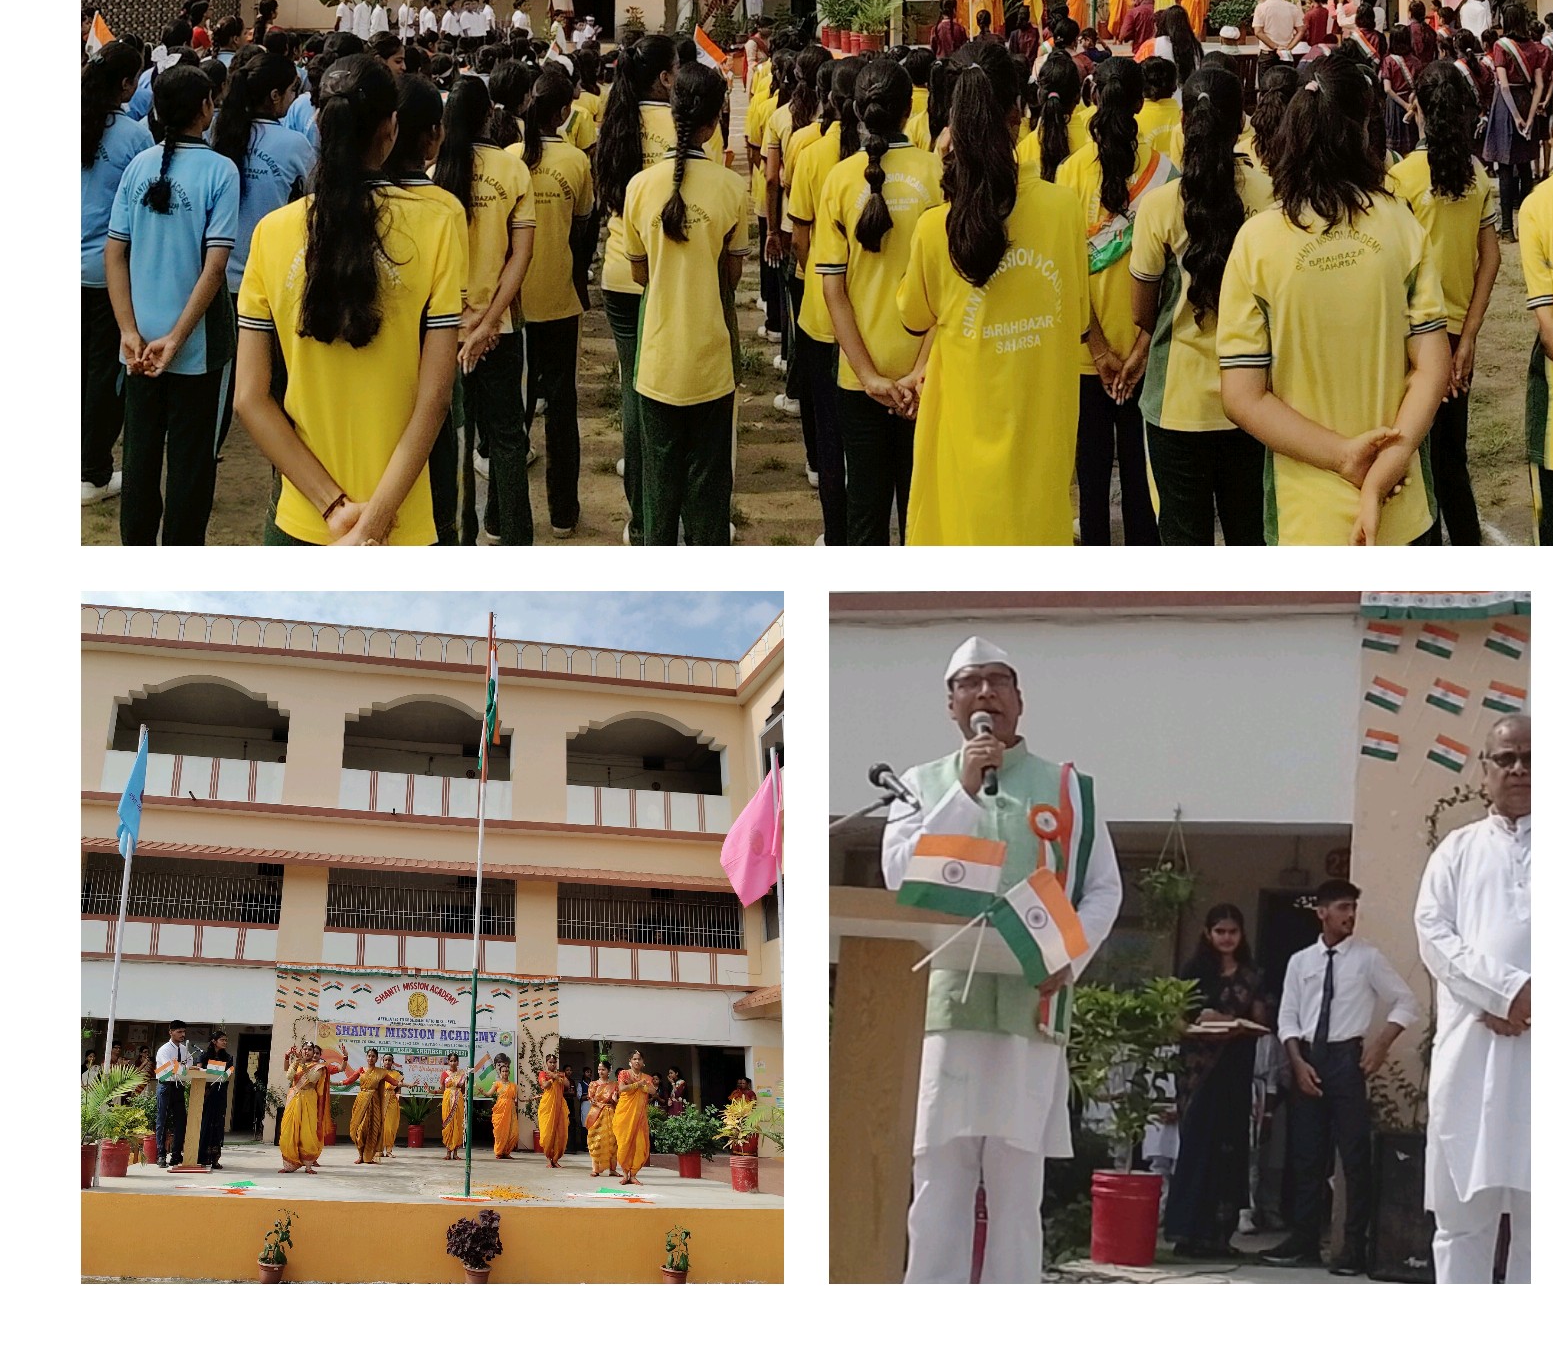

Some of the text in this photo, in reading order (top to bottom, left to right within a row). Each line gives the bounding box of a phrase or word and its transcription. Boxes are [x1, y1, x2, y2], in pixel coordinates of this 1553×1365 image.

[257, 150, 282, 177] ACADEMY
[485, 175, 508, 201] ACADEMY
[551, 169, 572, 201] ACADEMY
[374, 982, 459, 1006] SHANTI MISSION ACADEMY
[335, 1024, 380, 1037] SHANTI
[385, 1026, 435, 1040] MISSION
[440, 1029, 498, 1043] ACADEMY
